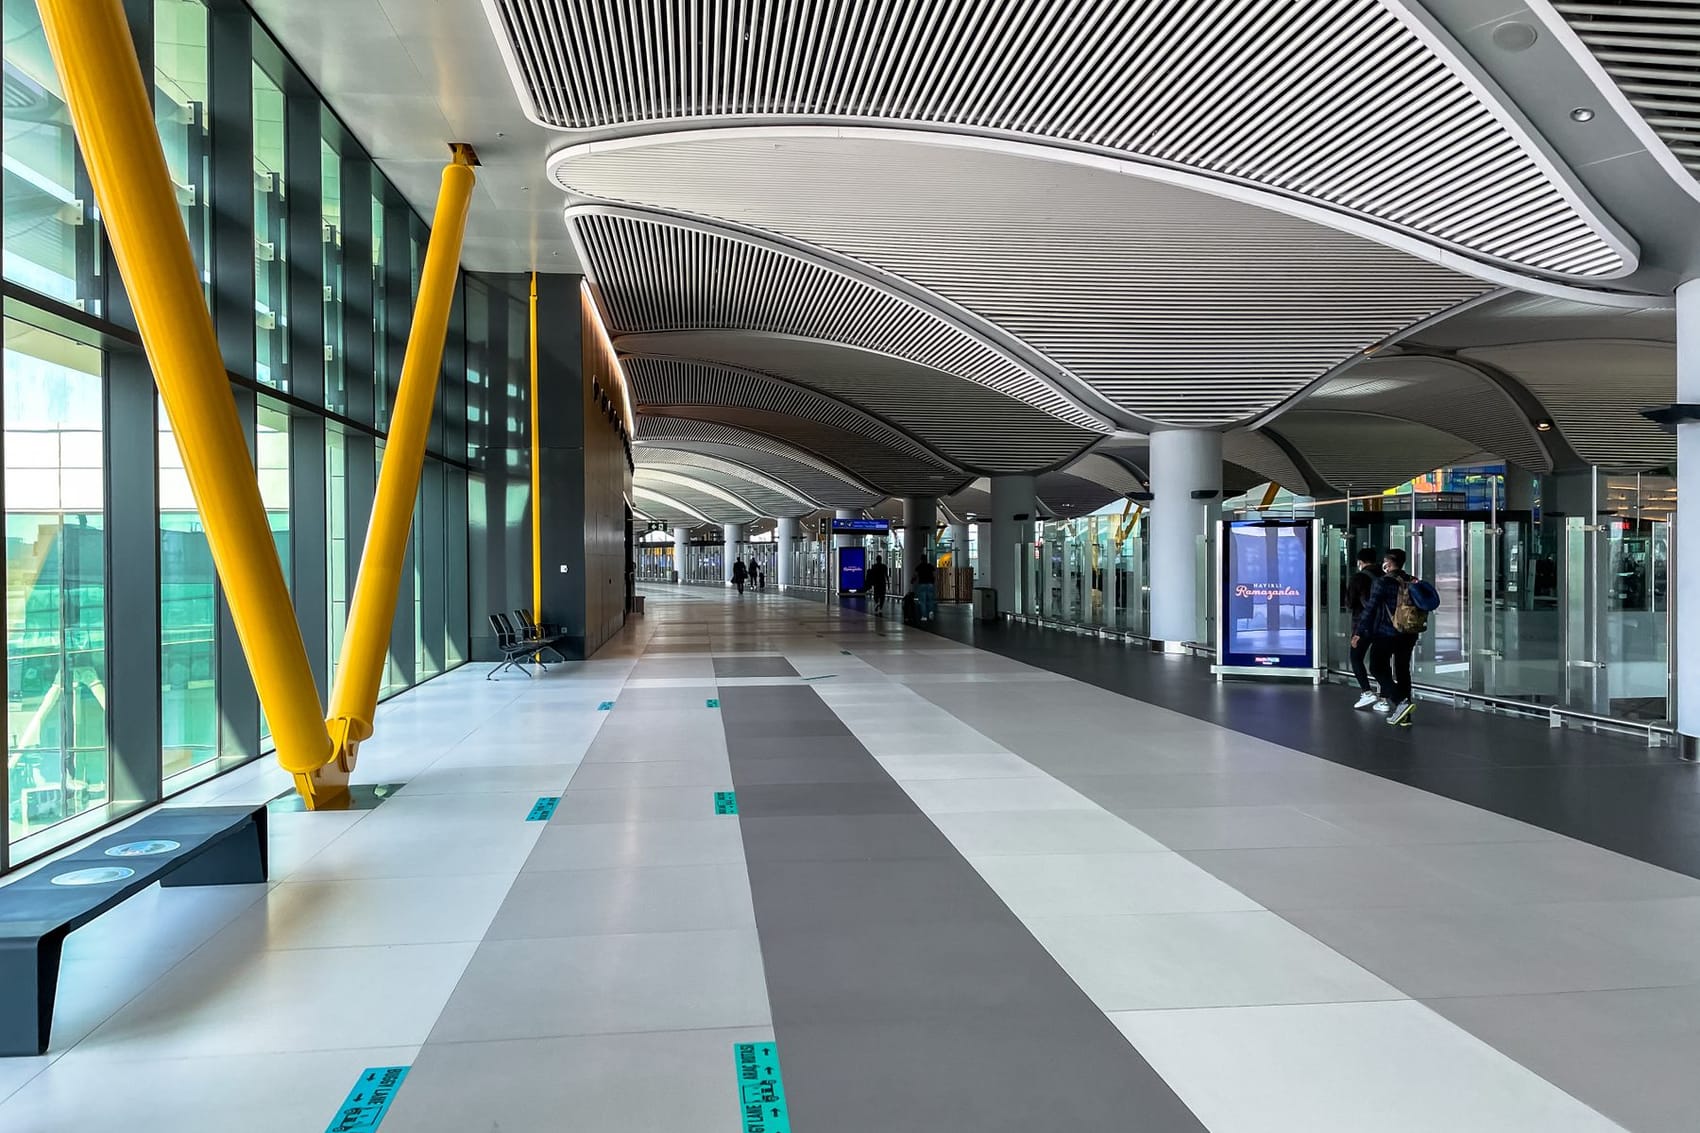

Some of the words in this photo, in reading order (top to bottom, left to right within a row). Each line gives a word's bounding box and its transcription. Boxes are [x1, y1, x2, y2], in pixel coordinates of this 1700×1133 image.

[1235, 585, 1300, 600] Ramazanlar
[367, 1088, 392, 1105] LANE
[746, 1104, 764, 1122] LANE
